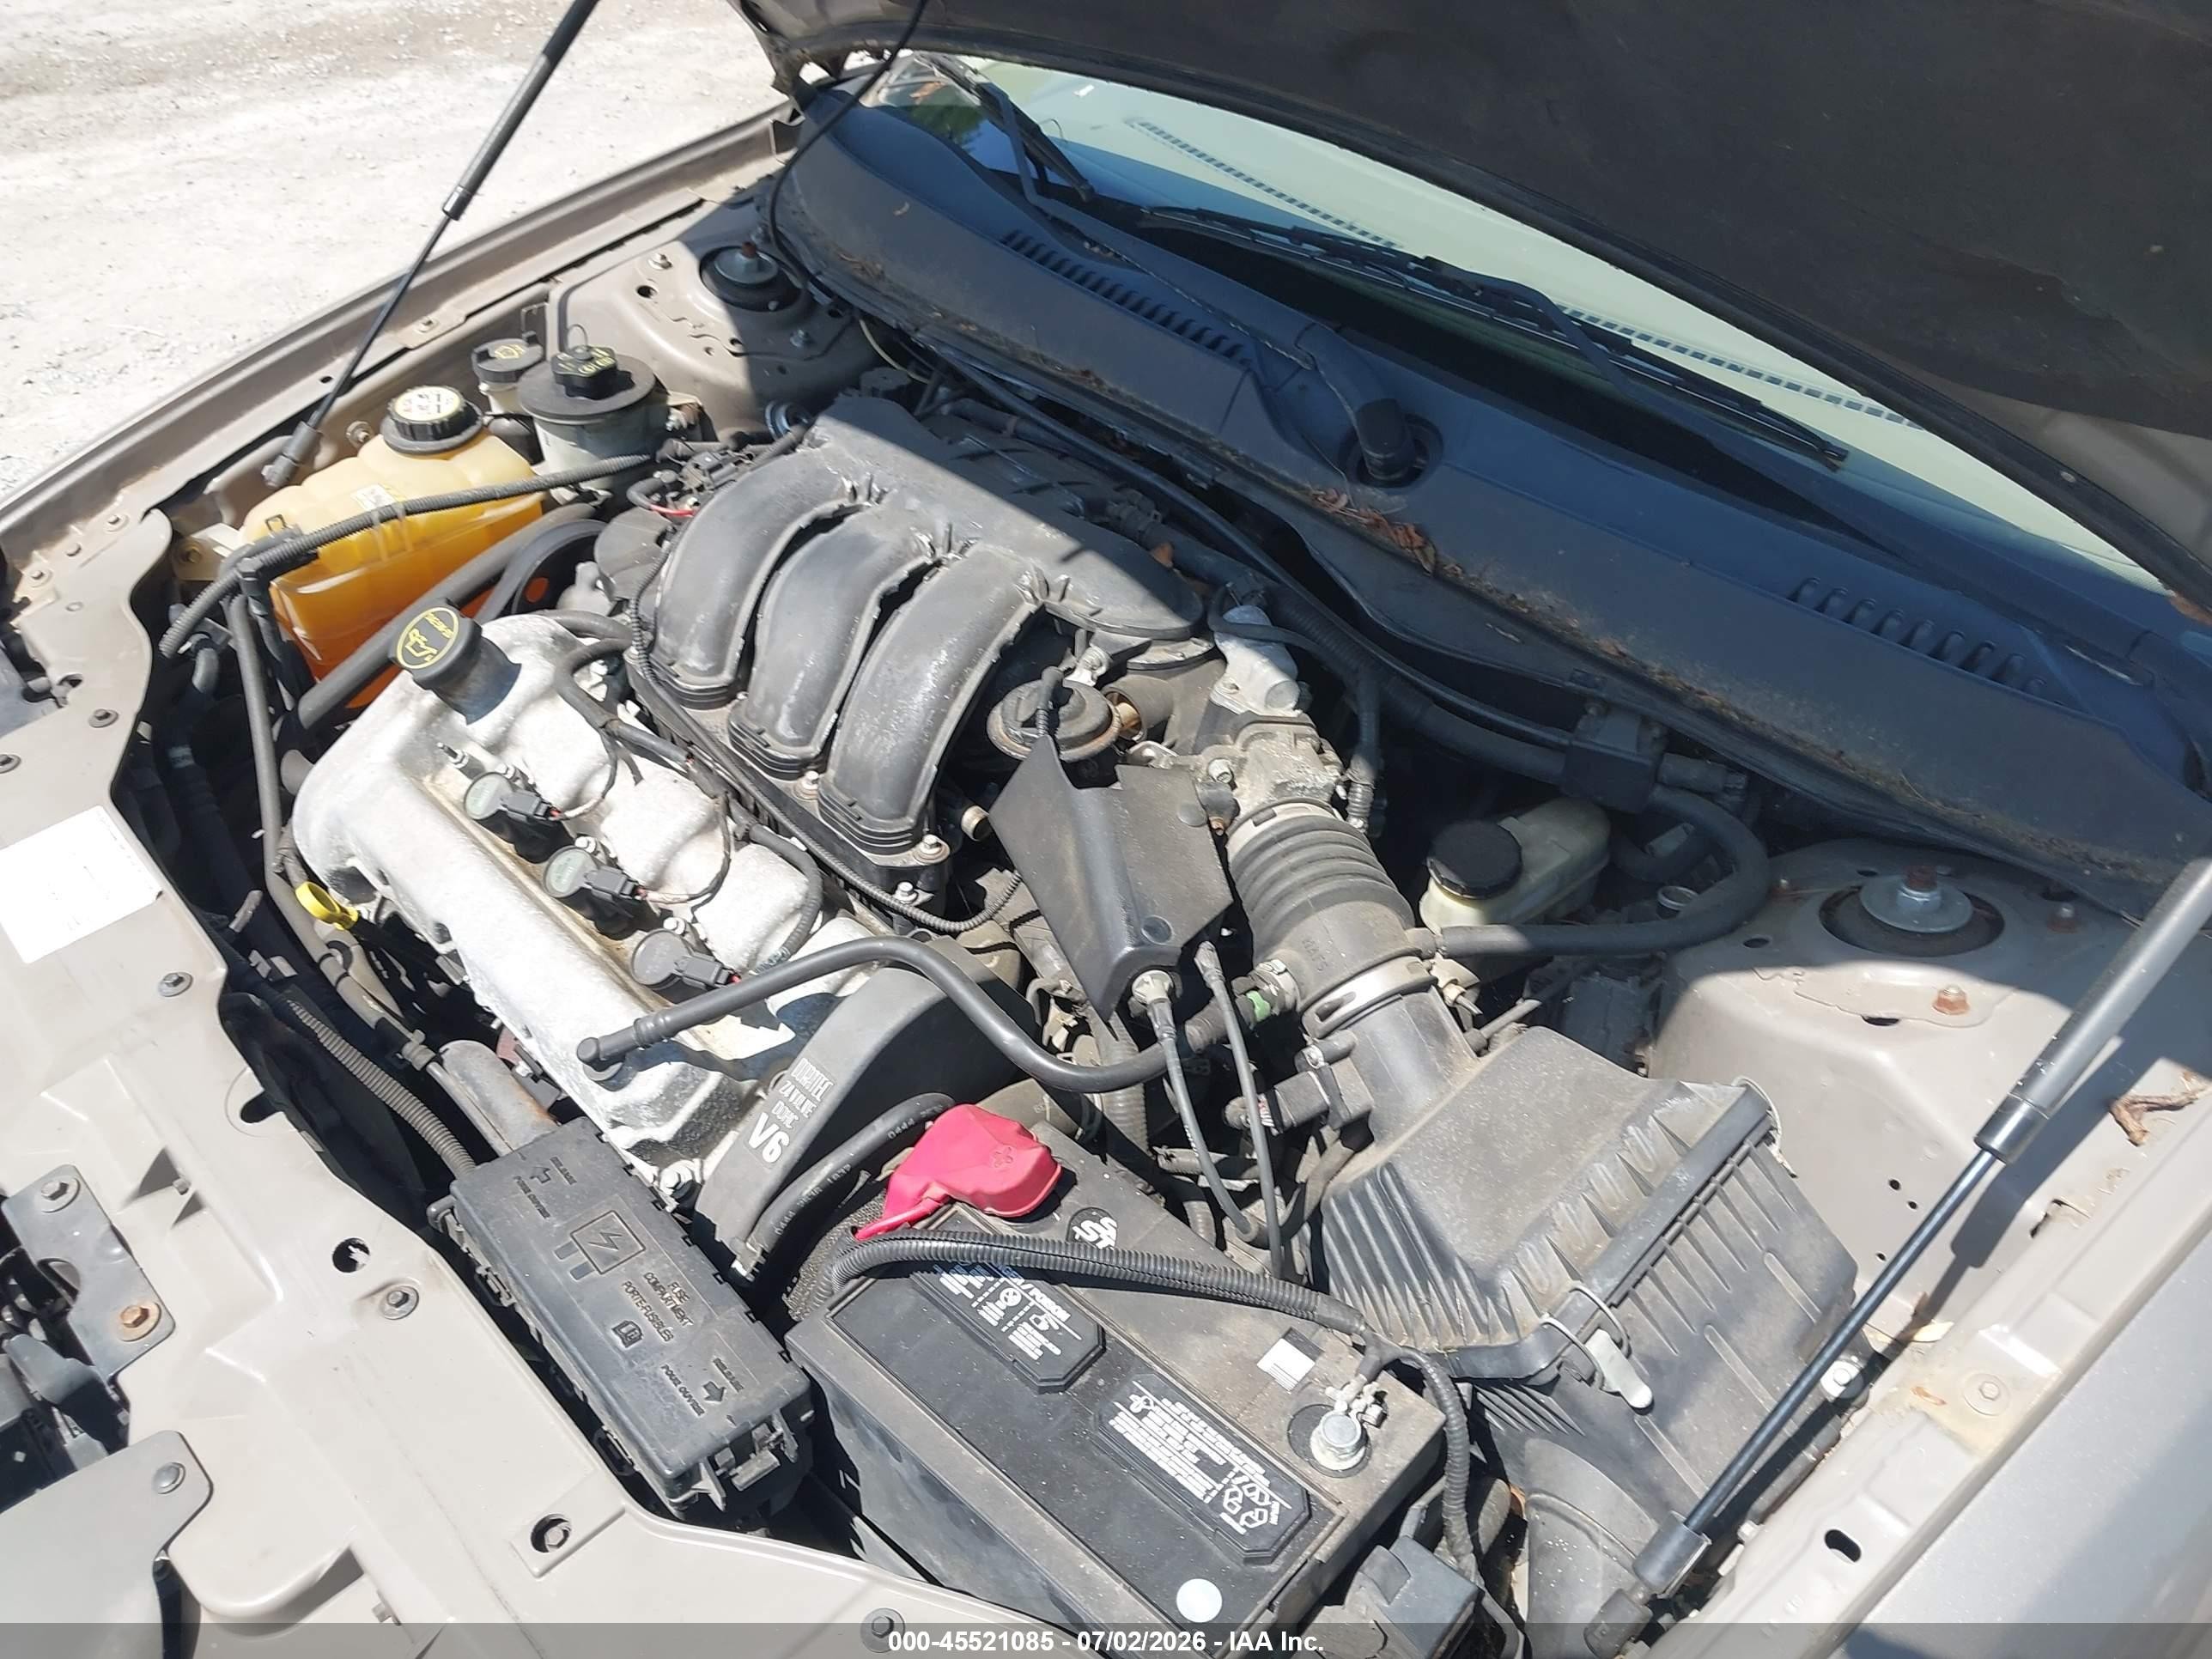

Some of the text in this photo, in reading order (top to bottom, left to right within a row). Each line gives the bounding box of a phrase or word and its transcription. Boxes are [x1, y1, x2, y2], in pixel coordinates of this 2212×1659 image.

[791, 1058, 835, 1103] DURATEC
[749, 1112, 790, 1163] V6
[771, 1100, 799, 1129] DOHC
[622, 1280, 674, 1342] PORTE-FUSIBLES
[643, 1272, 694, 1327] COMPARTMENT
[667, 1281, 690, 1304] FUSE
